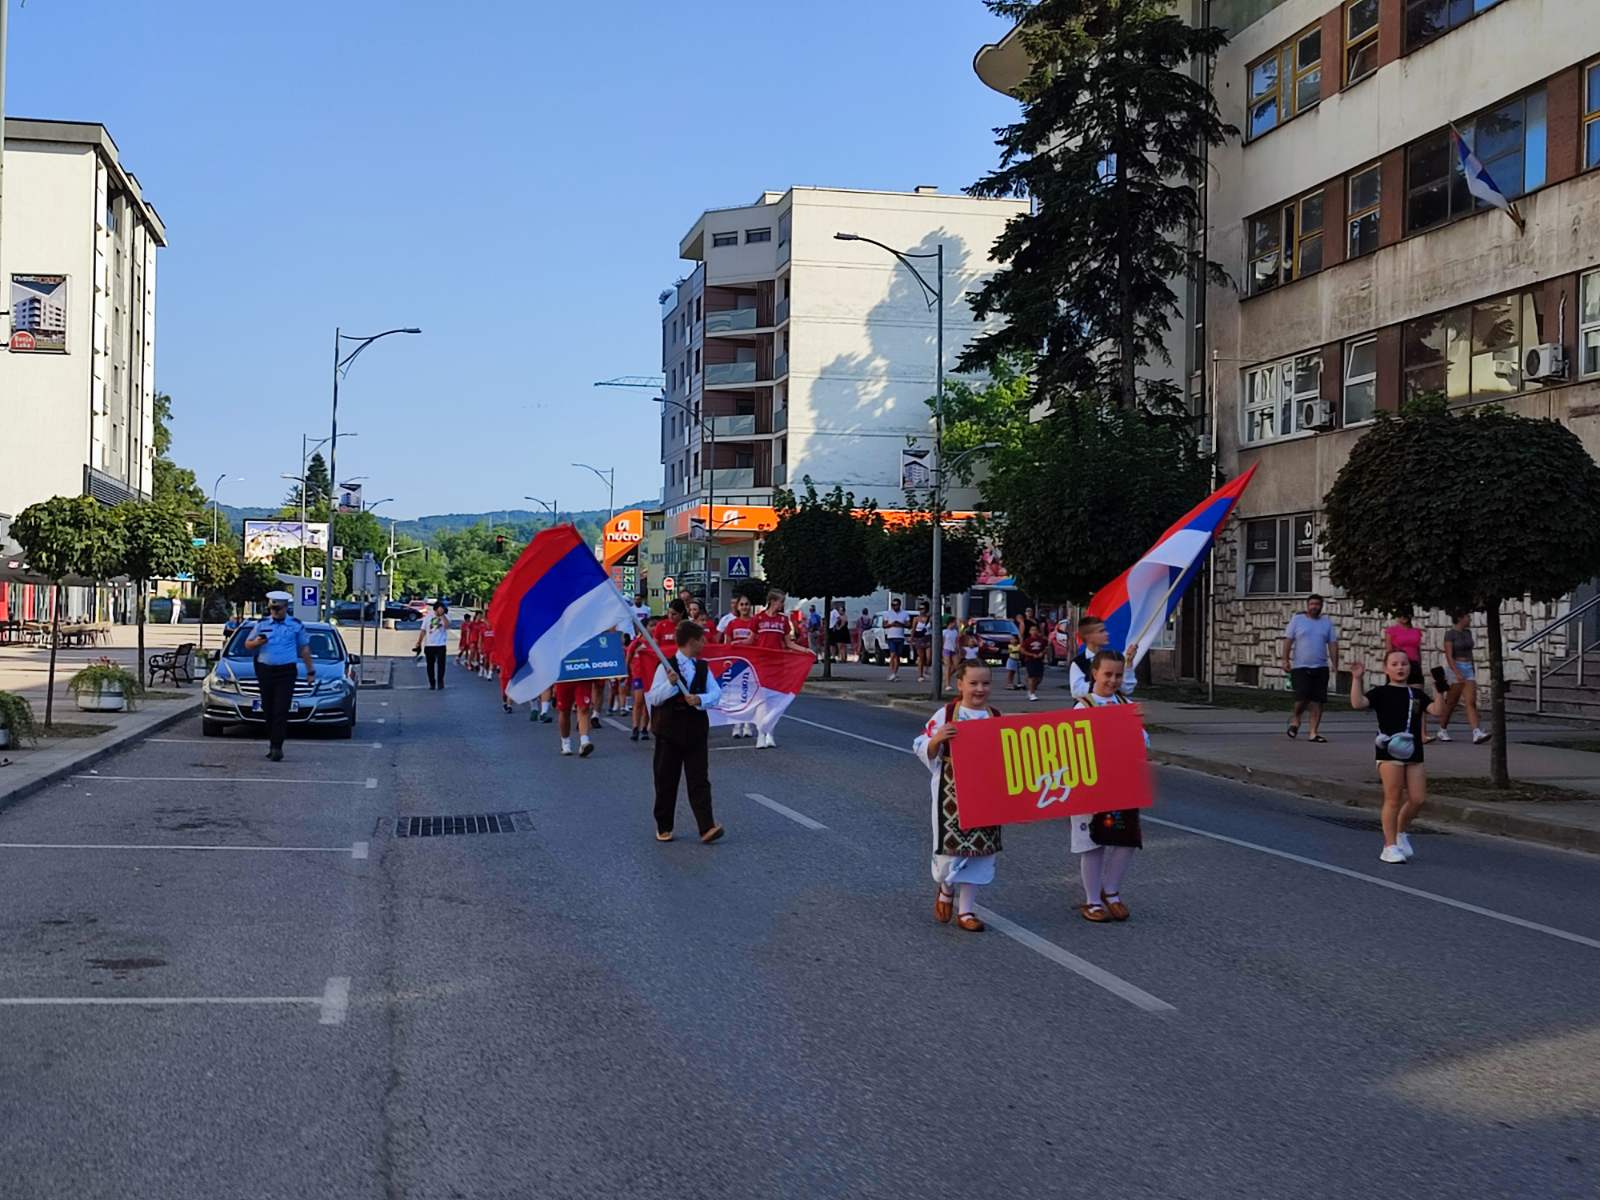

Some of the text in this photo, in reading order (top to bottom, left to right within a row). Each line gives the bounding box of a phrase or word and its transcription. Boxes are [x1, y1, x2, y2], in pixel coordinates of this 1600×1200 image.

[304, 587, 315, 600] P
[1000, 719, 1098, 795] DOBOJ
[1036, 767, 1071, 809] 25
